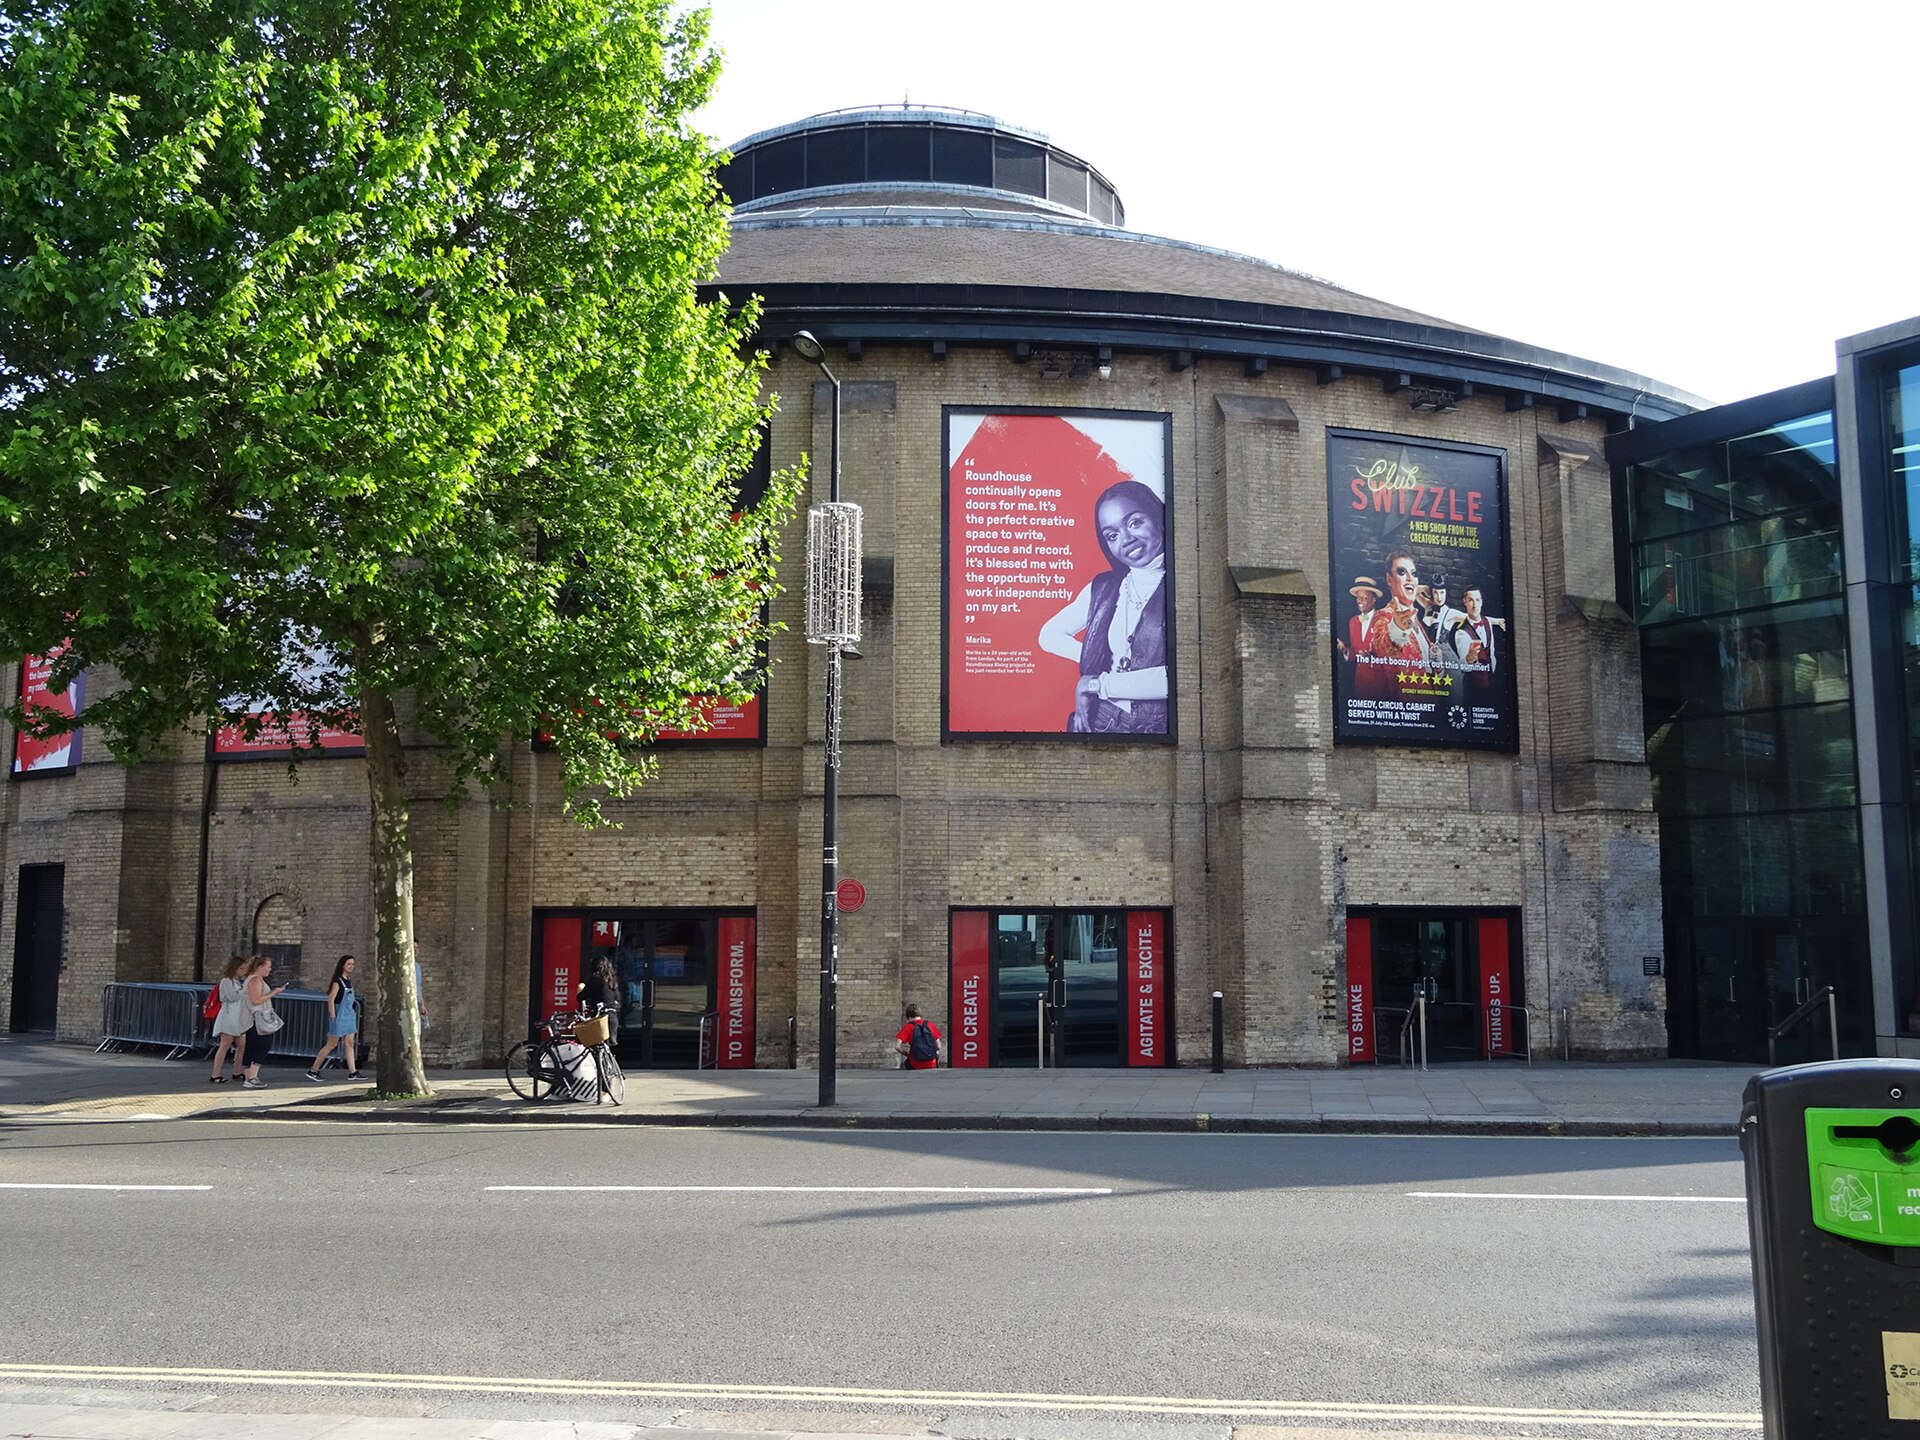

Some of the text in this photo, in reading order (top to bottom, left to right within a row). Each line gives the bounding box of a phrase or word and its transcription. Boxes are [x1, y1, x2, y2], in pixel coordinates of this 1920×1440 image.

[965, 470, 1032, 482] Roundhouse
[1355, 459, 1419, 492] Club
[965, 485, 1062, 500] continually opens
[965, 500, 997, 511] doors
[999, 501, 1015, 511] for
[1017, 503, 1037, 512] me.
[1351, 478, 1483, 523] SWIZZLE
[965, 514, 1075, 527] the perfect creative
[1415, 521, 1429, 532] NEW
[1430, 522, 1447, 534] SHOW
[965, 530, 1046, 542] space to write,
[1410, 532, 1440, 545] CREATORS
[965, 544, 1073, 556] produce and record.
[985, 559, 1028, 569] blessed
[1030, 560, 1047, 570] me
[1048, 560, 1074, 570] with
[965, 572, 1066, 586] the opportunity to
[965, 587, 1073, 601] work independently
[965, 603, 1021, 614] on my art.
[965, 636, 992, 644] Marika
[1355, 654, 1490, 672] The best boozy night out this summer!
[1347, 699, 1436, 712] COMEDY, CIRCUS, CABARET
[1347, 709, 1421, 721] SERVED WITH A TWIST
[554, 967, 569, 1006] HERE
[1138, 923, 1154, 1058] AGITATE & EXCITE.
[728, 940, 744, 1060] TO TRANSFORM.
[963, 975, 979, 1060] TO CREATE,
[1489, 972, 1502, 1050] THINGS UP.
[1350, 984, 1364, 1055] TO SHAKE
